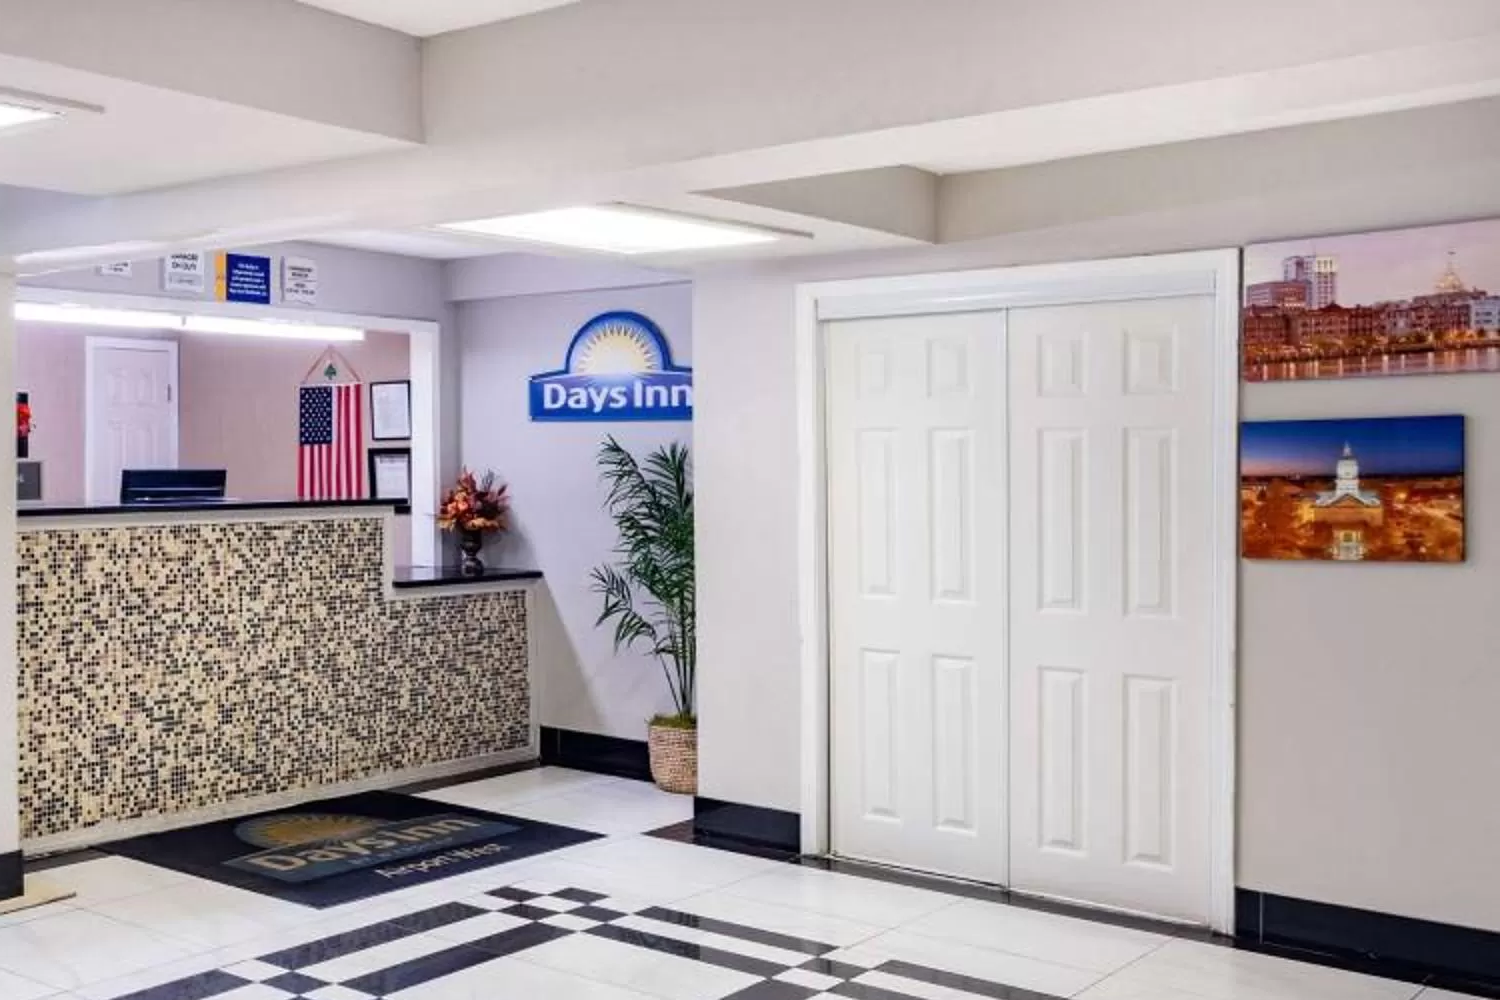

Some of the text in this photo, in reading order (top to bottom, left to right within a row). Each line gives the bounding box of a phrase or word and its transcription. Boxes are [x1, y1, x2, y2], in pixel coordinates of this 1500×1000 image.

[543, 381, 692, 413] Days Inn
[246, 833, 398, 871] Days
[389, 818, 480, 841] Inn
